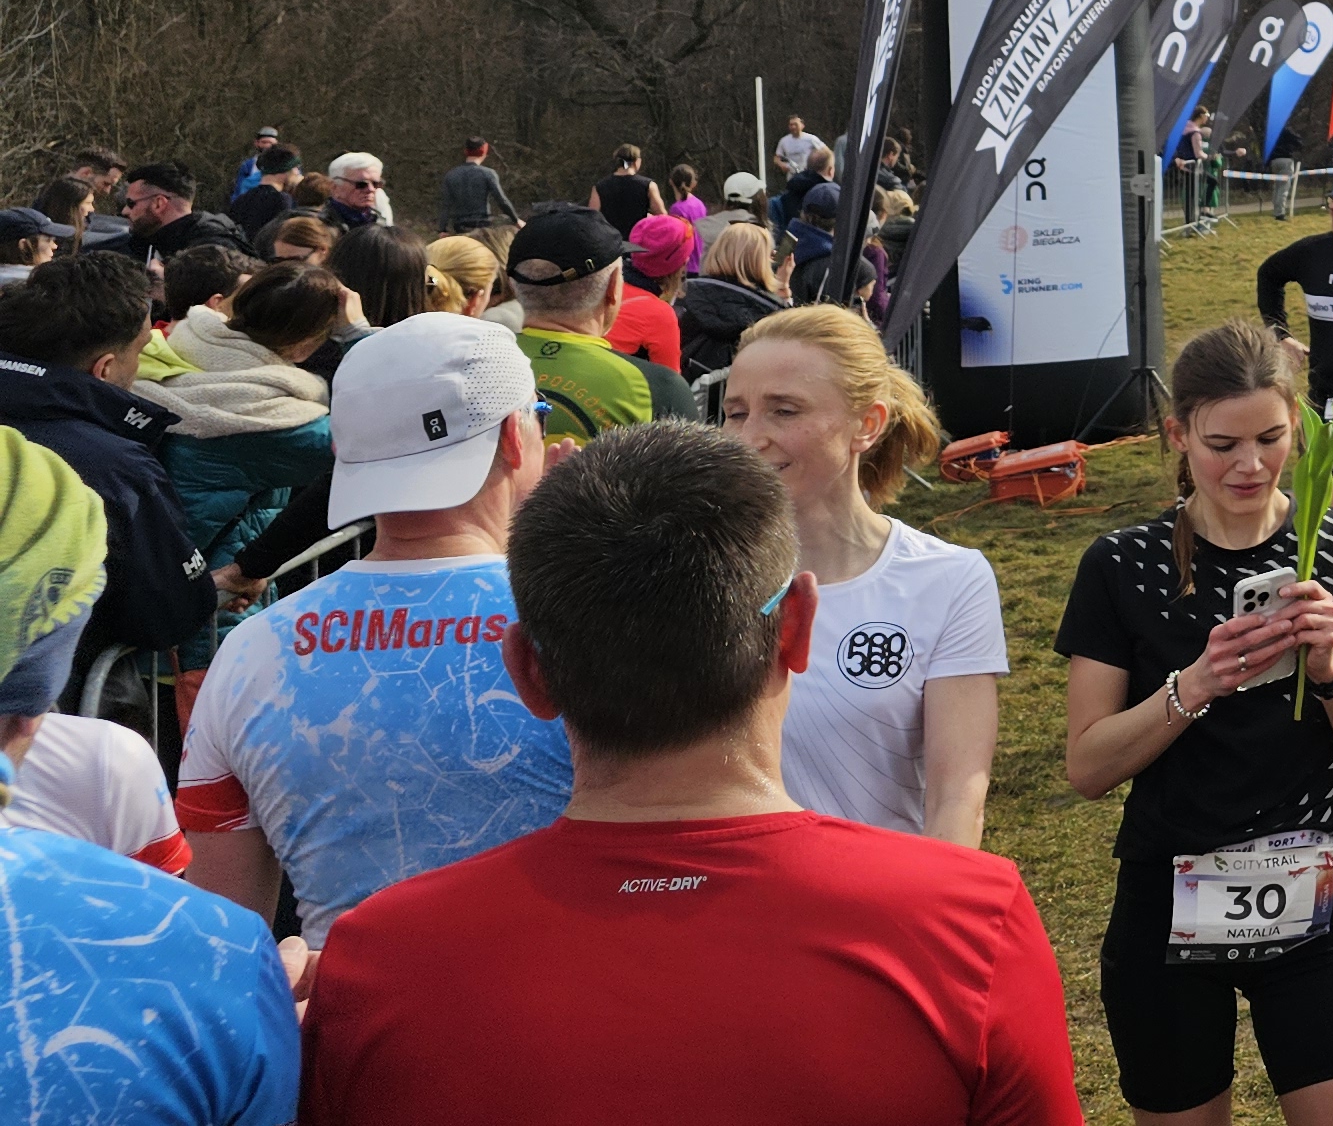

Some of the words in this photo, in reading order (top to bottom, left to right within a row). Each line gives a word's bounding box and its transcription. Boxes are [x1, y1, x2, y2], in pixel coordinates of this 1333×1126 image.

[988, 8, 1060, 121] ZMIANY
[1036, 43, 1074, 93] BATONY
[1070, 29, 1082, 44] Z
[971, 57, 1004, 107] 100%
[1033, 227, 1065, 238] SKLEP
[1032, 236, 1081, 247] BIEGACZA
[1017, 278, 1042, 286] KING
[1017, 282, 1083, 294] RUNNER.COM
[1223, 883, 1287, 921] 30
[1226, 925, 1281, 939] NATALIA
